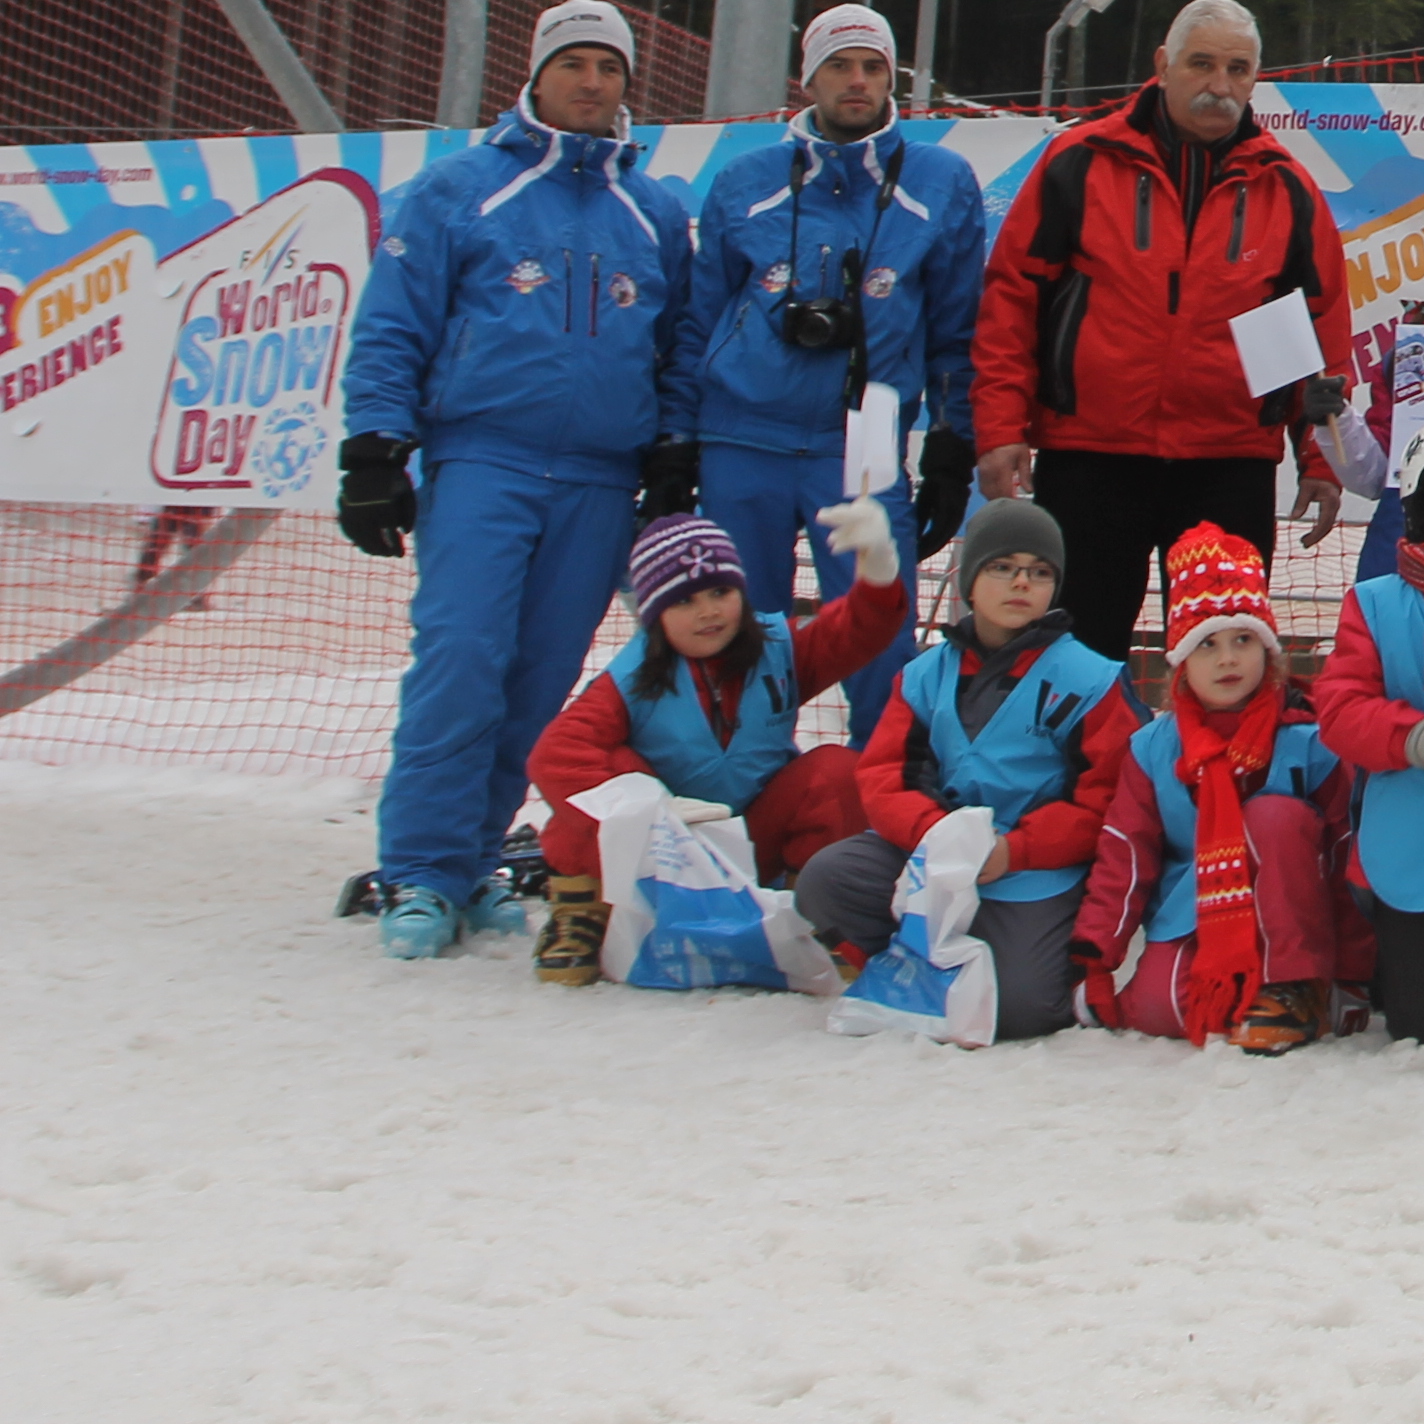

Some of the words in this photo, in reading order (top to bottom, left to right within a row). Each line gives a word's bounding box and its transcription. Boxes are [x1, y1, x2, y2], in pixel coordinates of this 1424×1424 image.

[38, 250, 132, 338] ENJOY
[218, 272, 322, 337] World
[173, 409, 256, 476] Day
